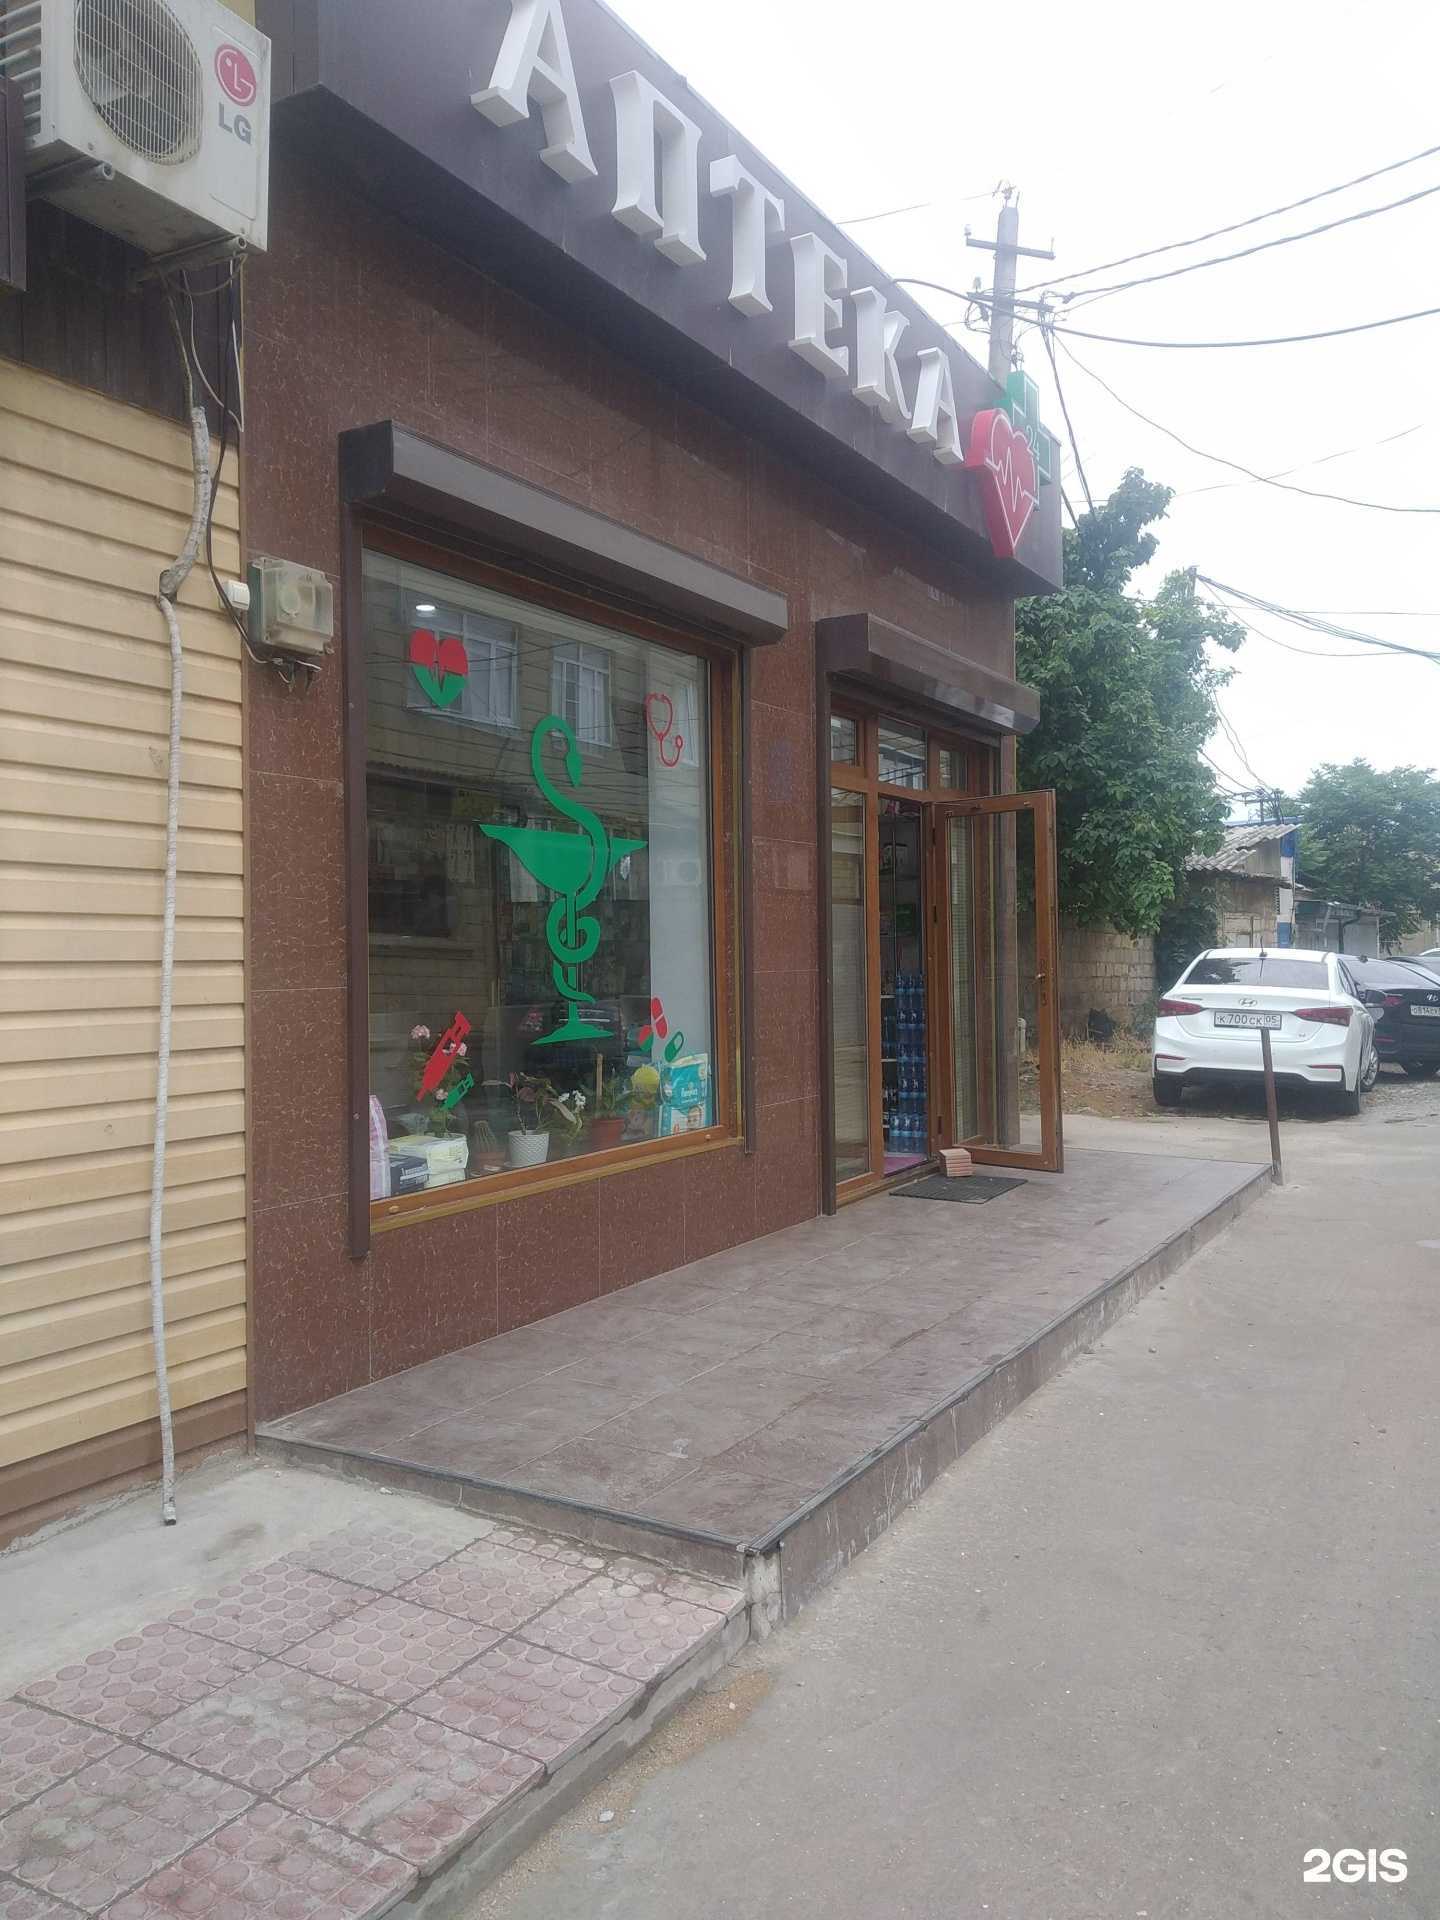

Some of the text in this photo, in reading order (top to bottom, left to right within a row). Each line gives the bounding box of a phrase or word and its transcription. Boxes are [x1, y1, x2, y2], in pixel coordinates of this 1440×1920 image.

[218, 101, 252, 145] LG
[470, 0, 965, 465] АПТЕКА
[1026, 424, 1040, 462] 24
